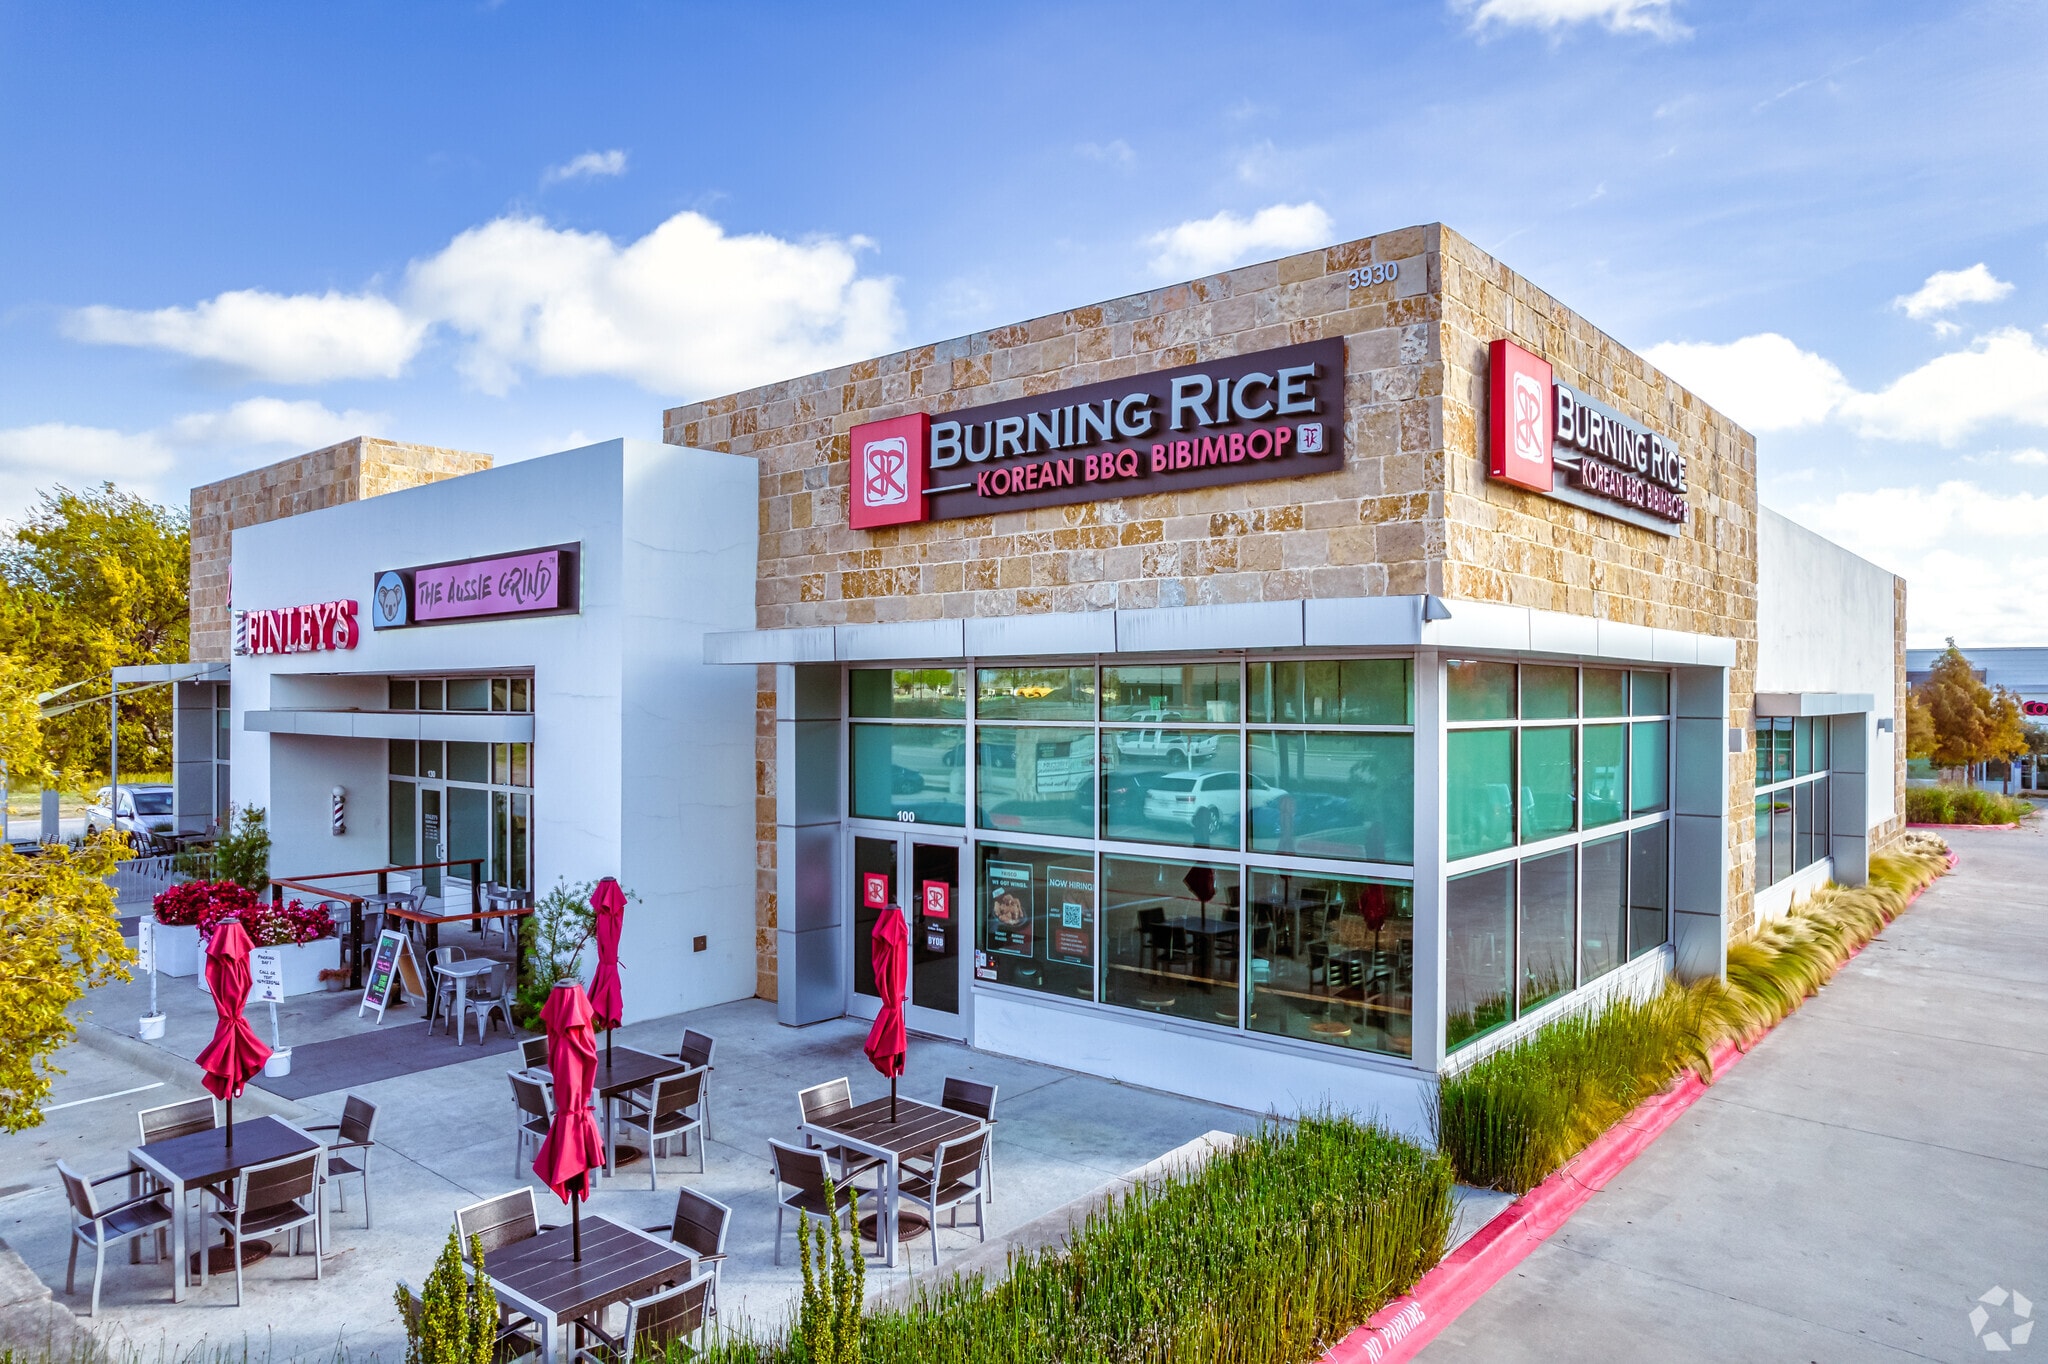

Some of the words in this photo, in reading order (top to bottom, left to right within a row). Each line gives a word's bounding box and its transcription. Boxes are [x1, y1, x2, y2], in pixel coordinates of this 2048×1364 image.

[1347, 261, 1399, 291] 3930
[928, 391, 1154, 470] BURNING
[1168, 360, 1318, 431] RICE
[1555, 383, 1648, 474] BURNING
[1650, 432, 1688, 493] RICE
[976, 457, 1076, 498] KOREAN
[1084, 447, 1140, 483] BBQ
[1150, 425, 1293, 473] BIBIMBOP
[1581, 457, 1625, 499] KOREAN
[1626, 475, 1646, 508] BBQ
[418, 580, 443, 613] THE
[447, 573, 493, 605] AUSSIE
[498, 559, 552, 605] GRIND
[246, 598, 356, 655] FINLEY'S
[896, 810, 916, 823] 100
[1049, 878, 1068, 888] NOW
[1361, 1336, 1383, 1364] NO
[1379, 1301, 1426, 1350] PARKING
